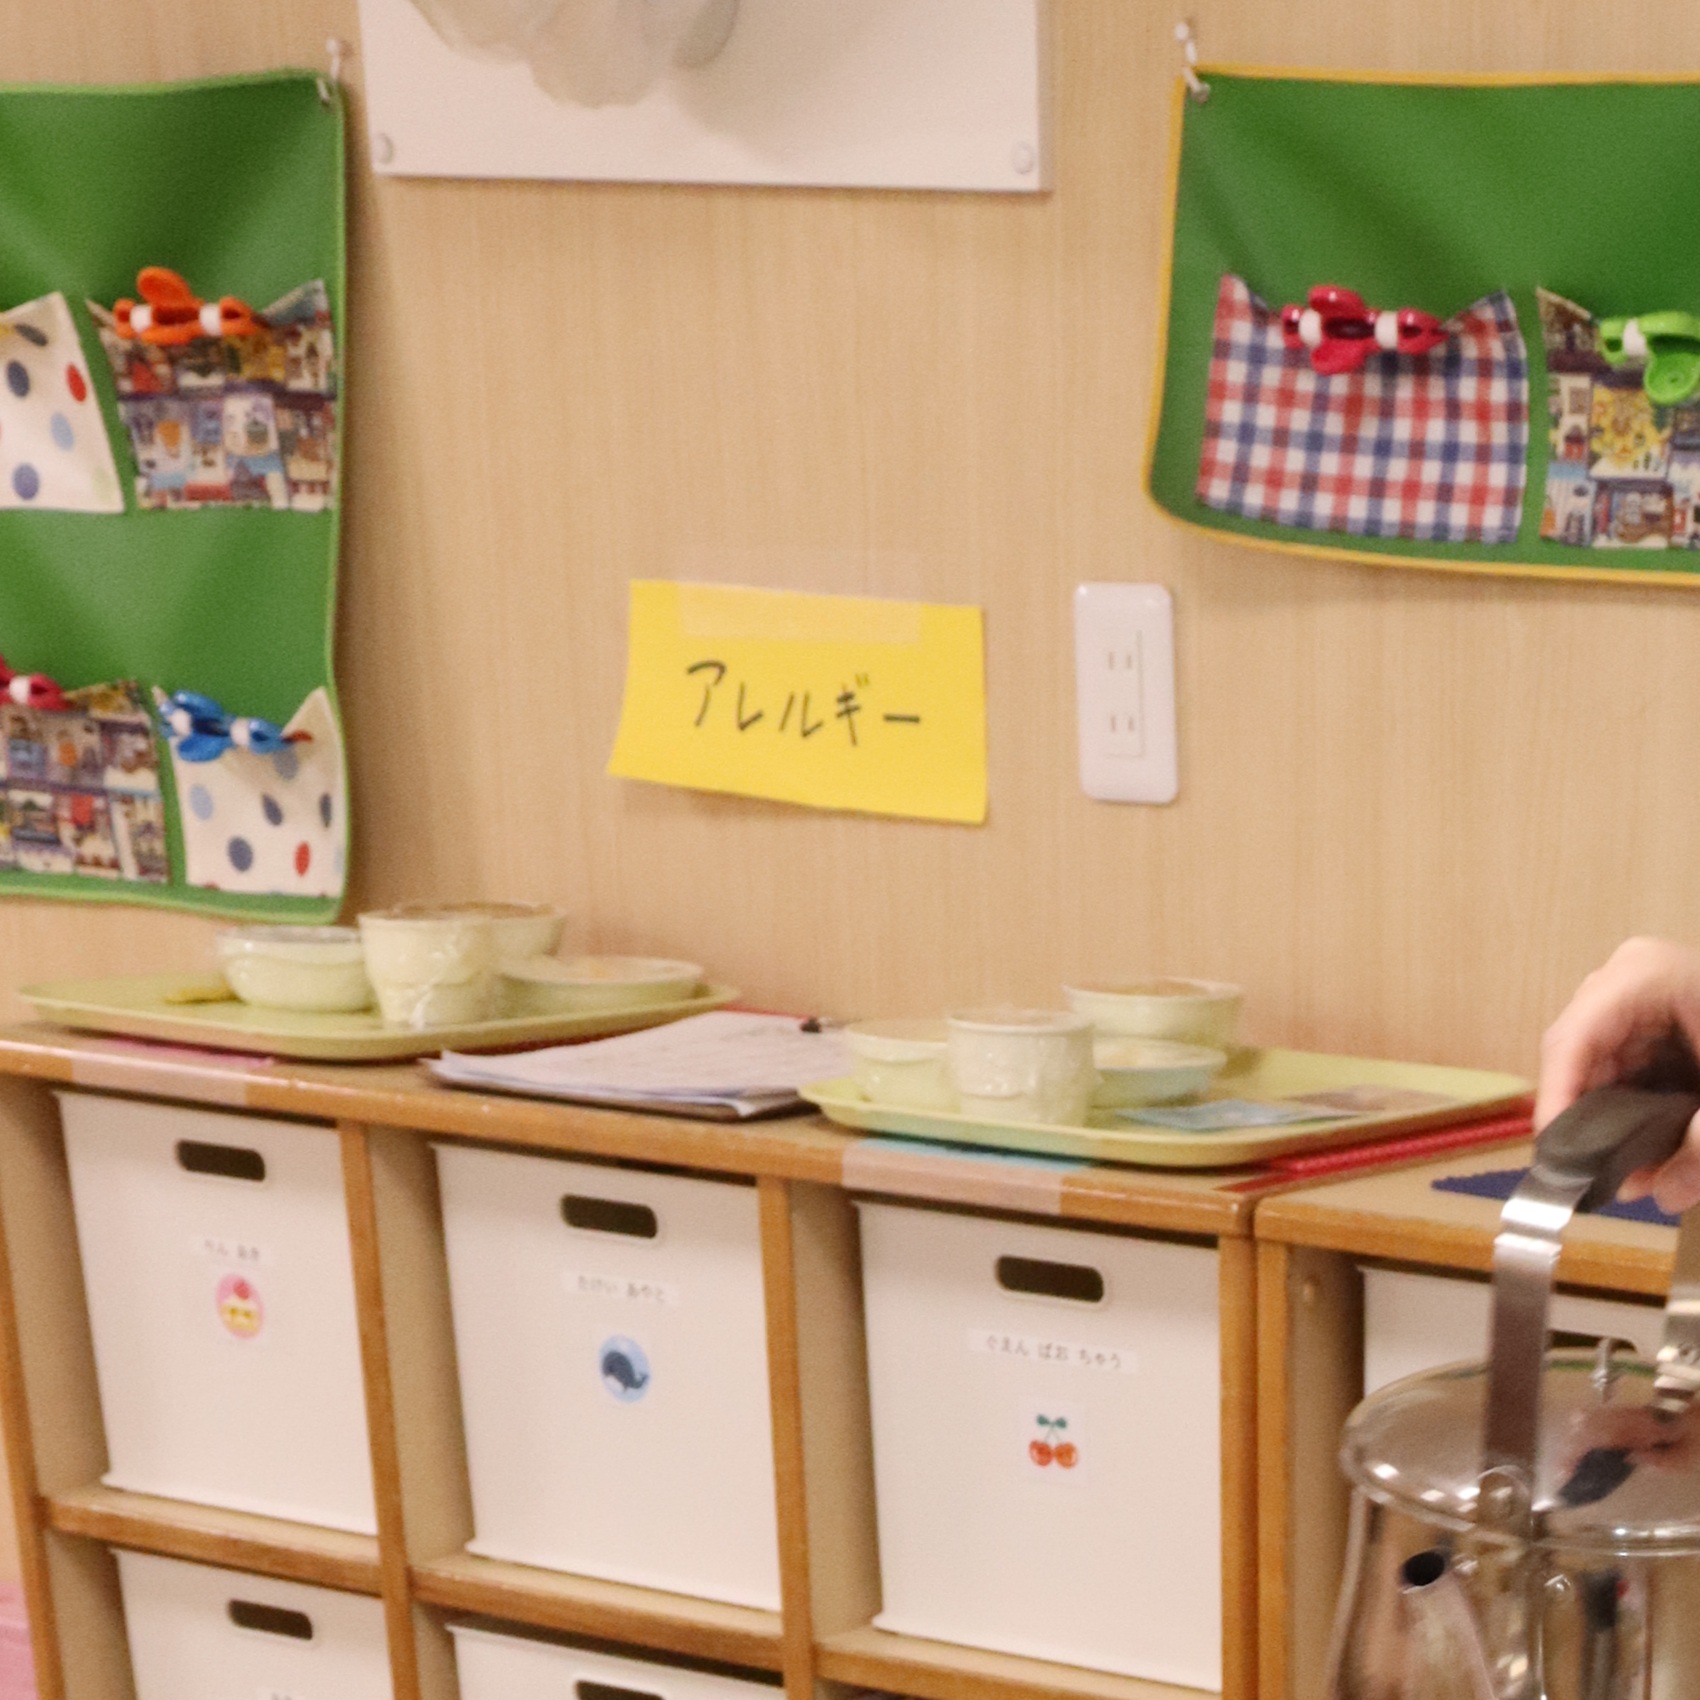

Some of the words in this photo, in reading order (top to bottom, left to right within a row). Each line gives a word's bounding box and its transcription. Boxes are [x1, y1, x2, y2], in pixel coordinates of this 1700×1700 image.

[687, 659, 921, 746] アレルギー
